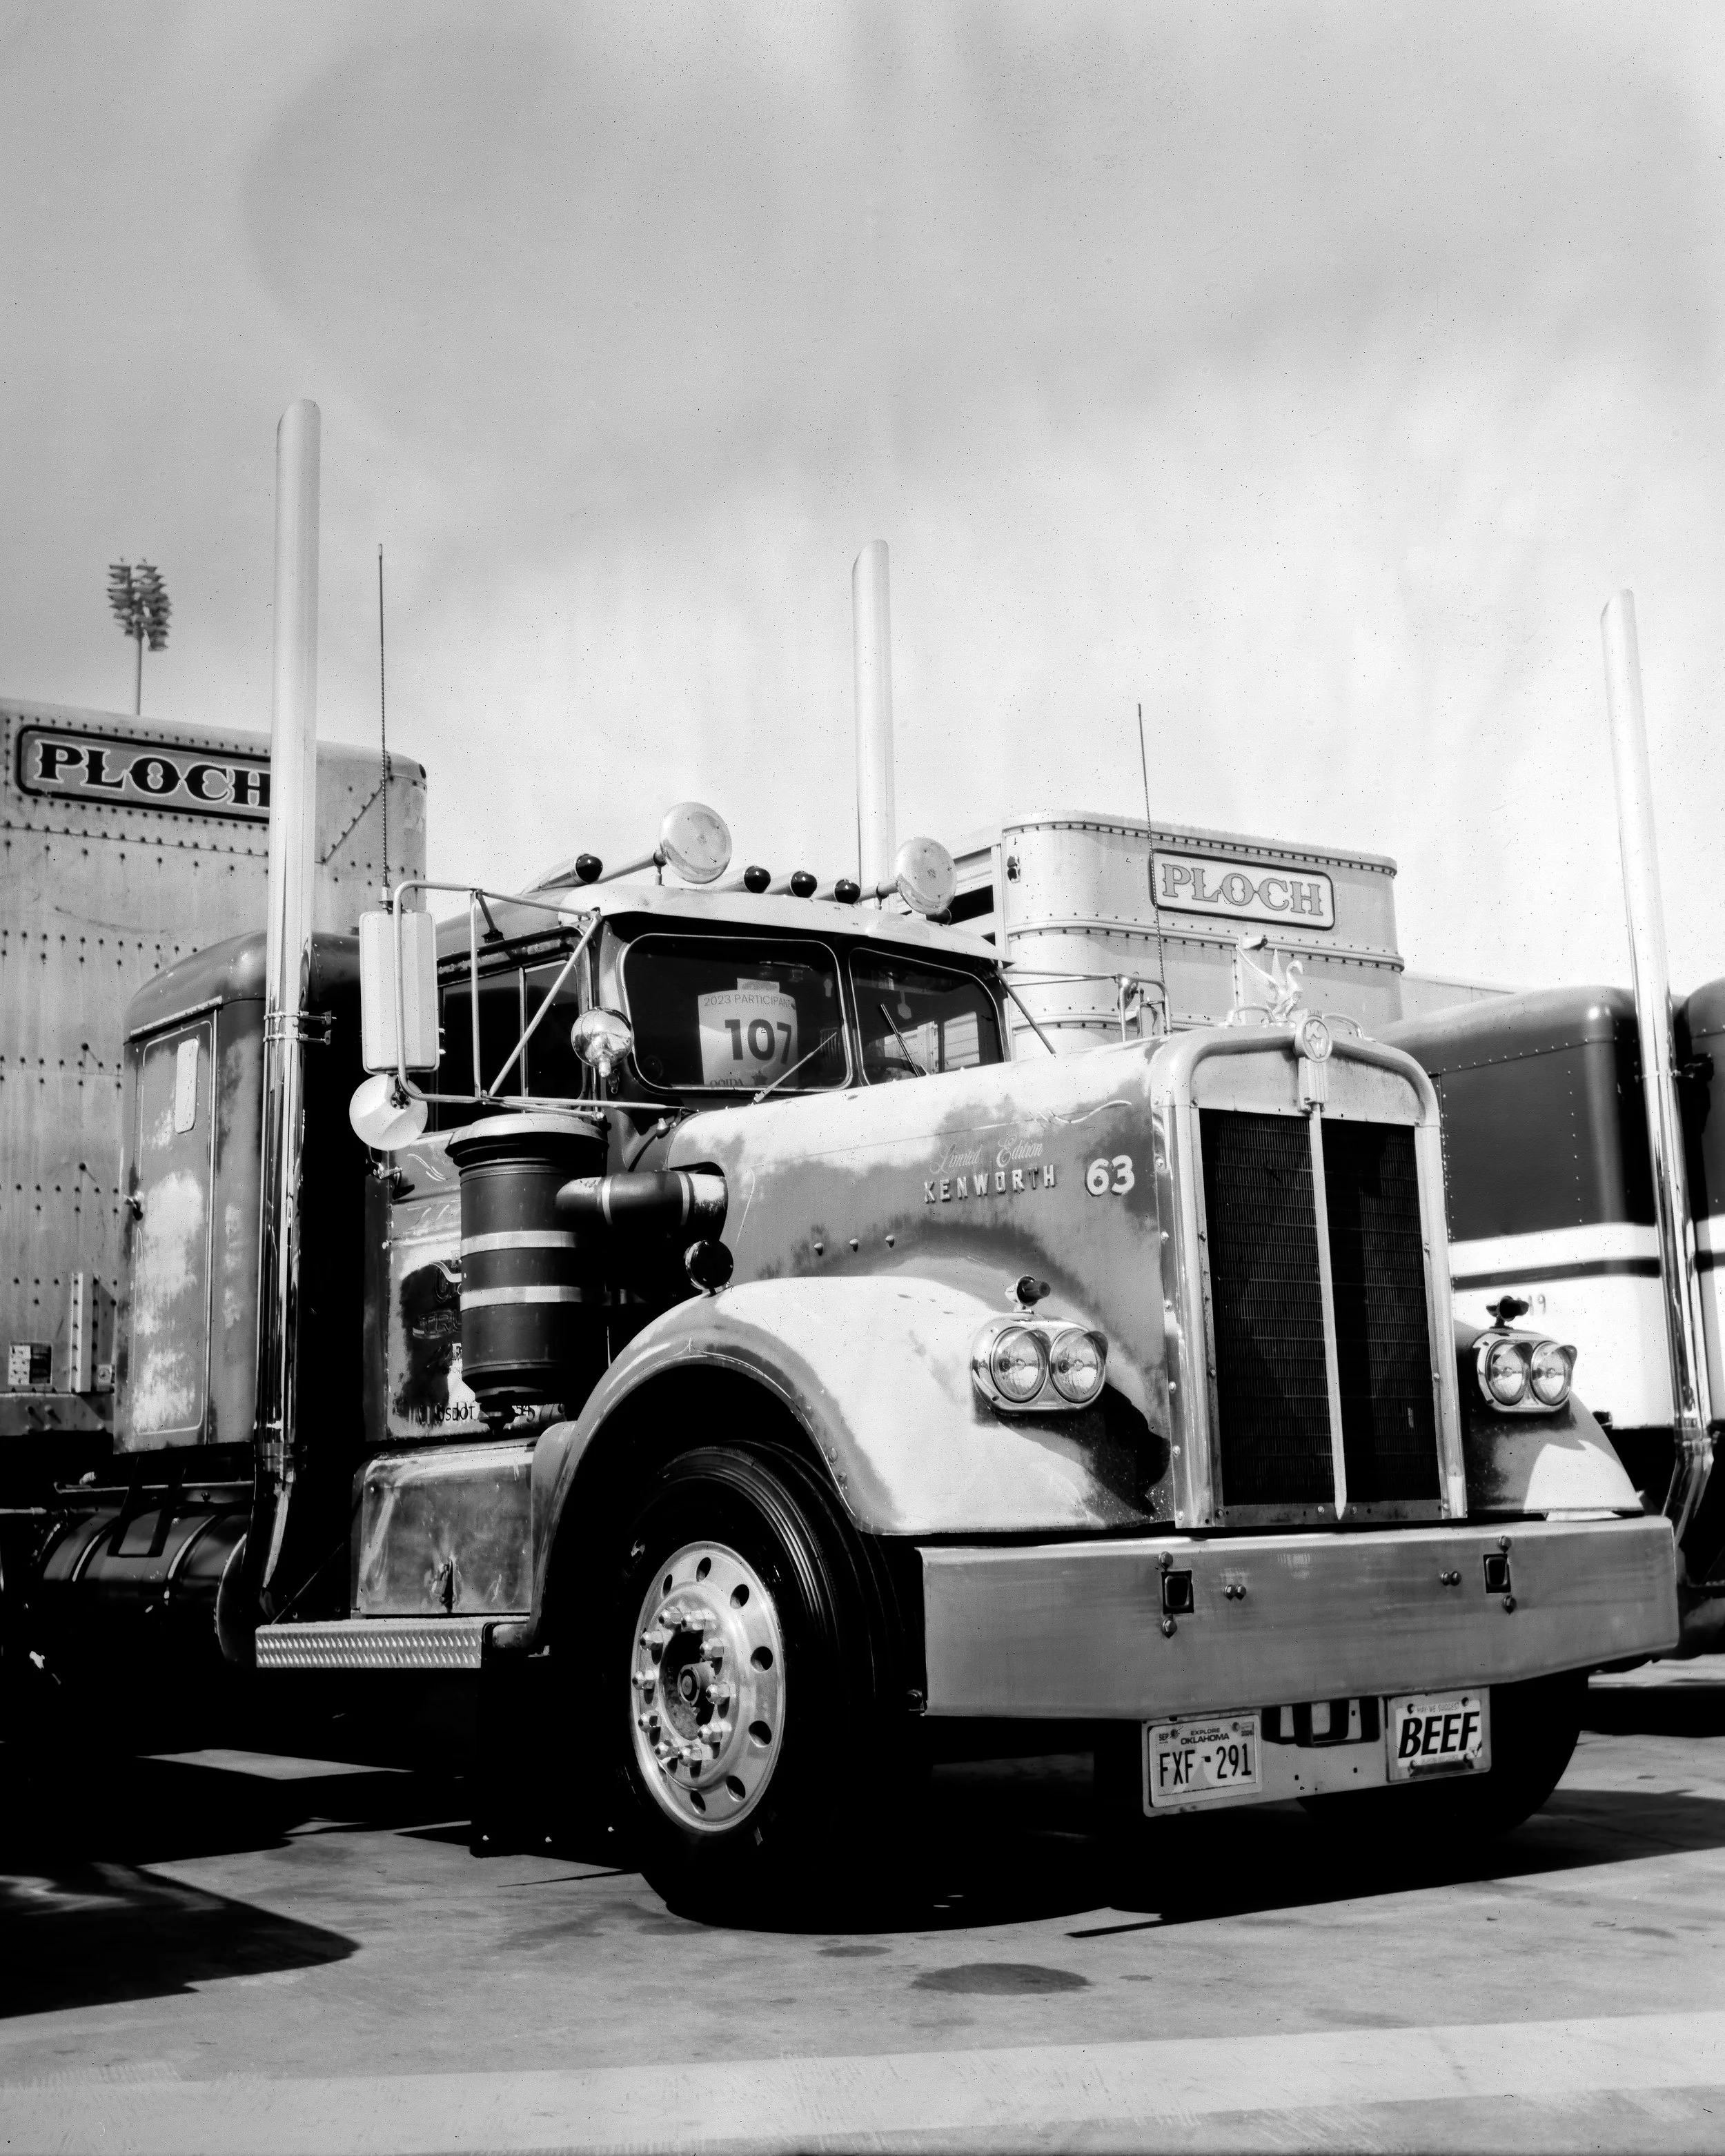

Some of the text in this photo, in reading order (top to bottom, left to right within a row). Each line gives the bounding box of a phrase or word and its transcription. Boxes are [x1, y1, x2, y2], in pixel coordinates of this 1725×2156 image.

[34, 740, 270, 809] PLOCH
[1162, 864, 1323, 916] PLOCH
[704, 995, 731, 1007] 2023
[724, 1018, 791, 1065] 107
[996, 1134, 1043, 1167] Edition
[923, 1165, 1056, 1203] KENWORTH
[1085, 1155, 1135, 1197] 63
[1181, 1733, 1230, 1745] OKLAHOMA
[1190, 1728, 1221, 1736] EXPLORE
[1399, 1711, 1480, 1759] BEEF
[1160, 1743, 1252, 1787] FXF 291
